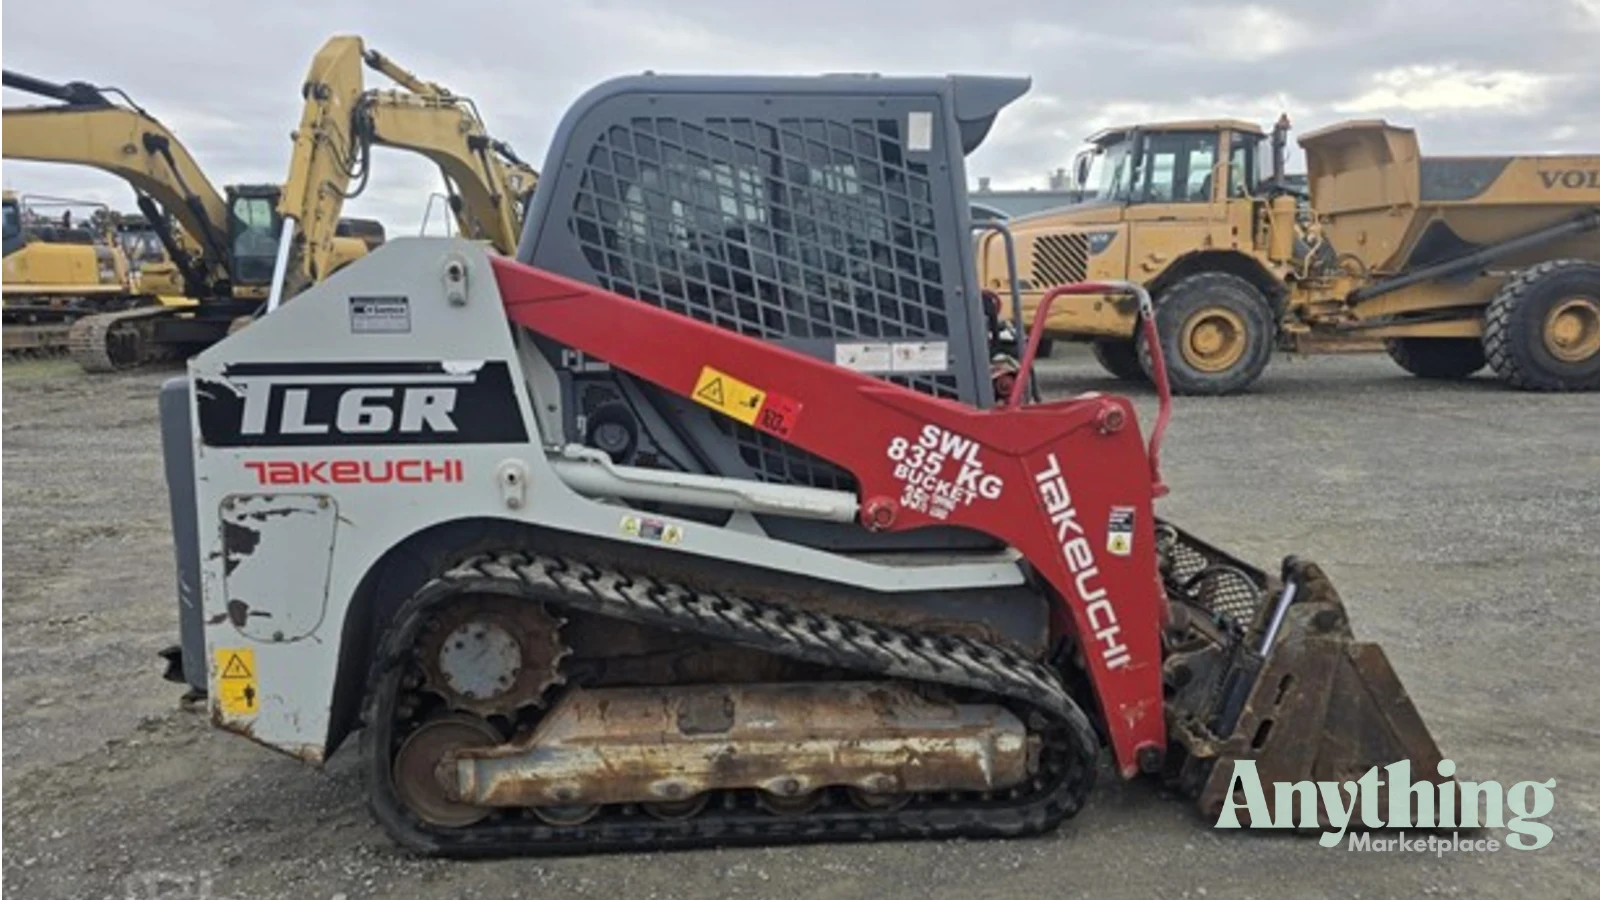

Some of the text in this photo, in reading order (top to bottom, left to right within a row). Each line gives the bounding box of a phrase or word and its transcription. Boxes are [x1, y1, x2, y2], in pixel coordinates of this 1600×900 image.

[228, 375, 476, 434] TL6R
[887, 437, 1004, 500] 835 KG
[919, 424, 983, 469] SWL
[893, 463, 978, 507] BUCKET
